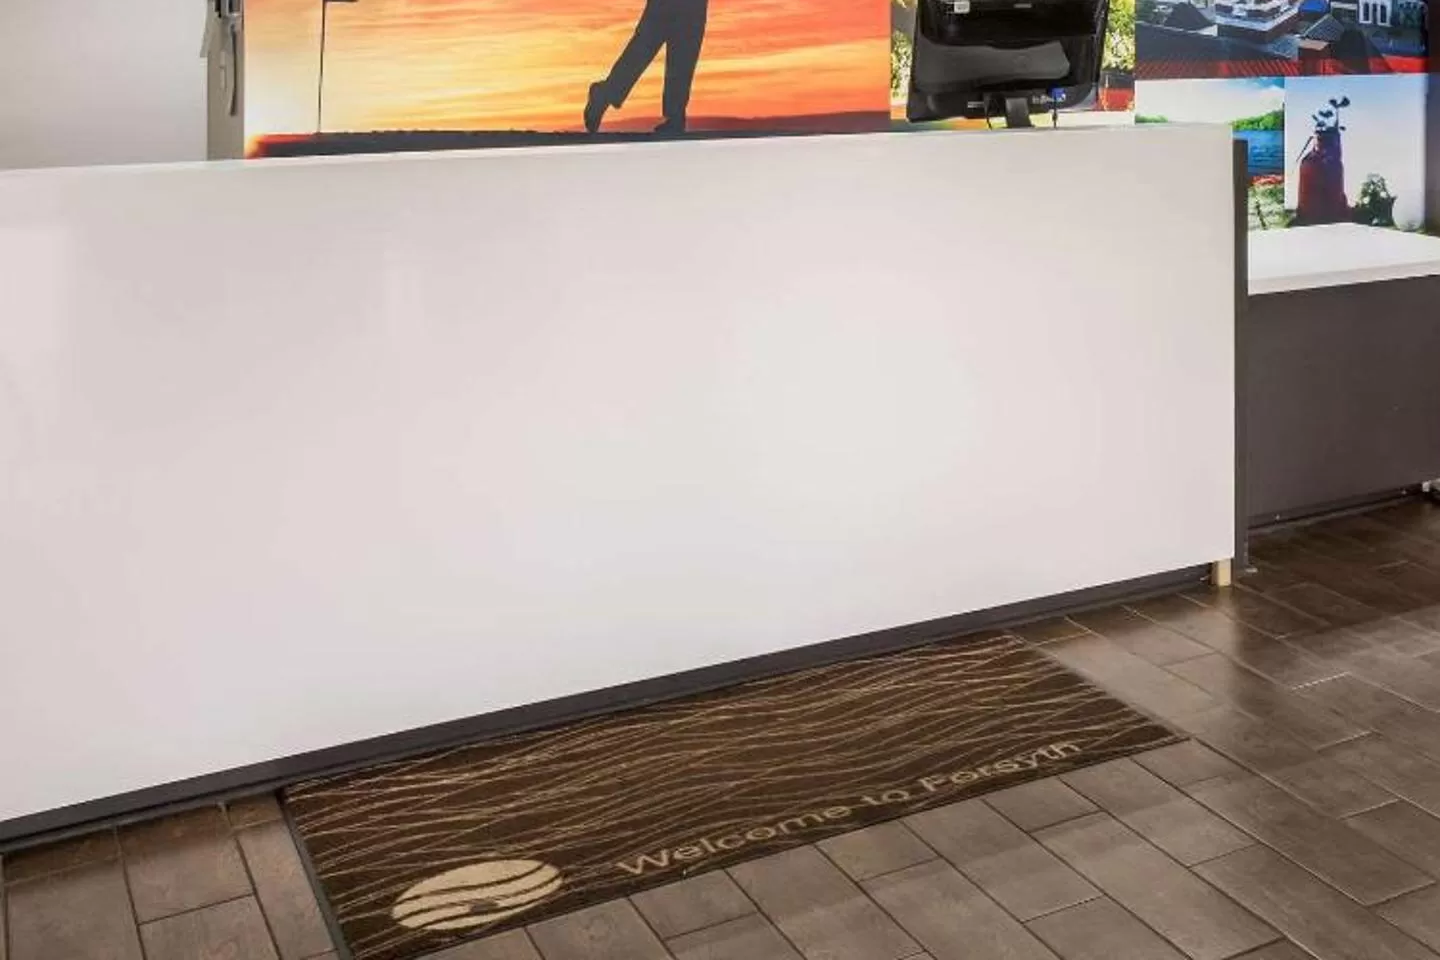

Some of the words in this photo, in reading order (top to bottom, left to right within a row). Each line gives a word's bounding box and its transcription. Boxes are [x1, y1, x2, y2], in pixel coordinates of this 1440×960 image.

[615, 805, 852, 876] Welcome
[860, 789, 910, 807] to
[918, 739, 1082, 792] Forsyth
